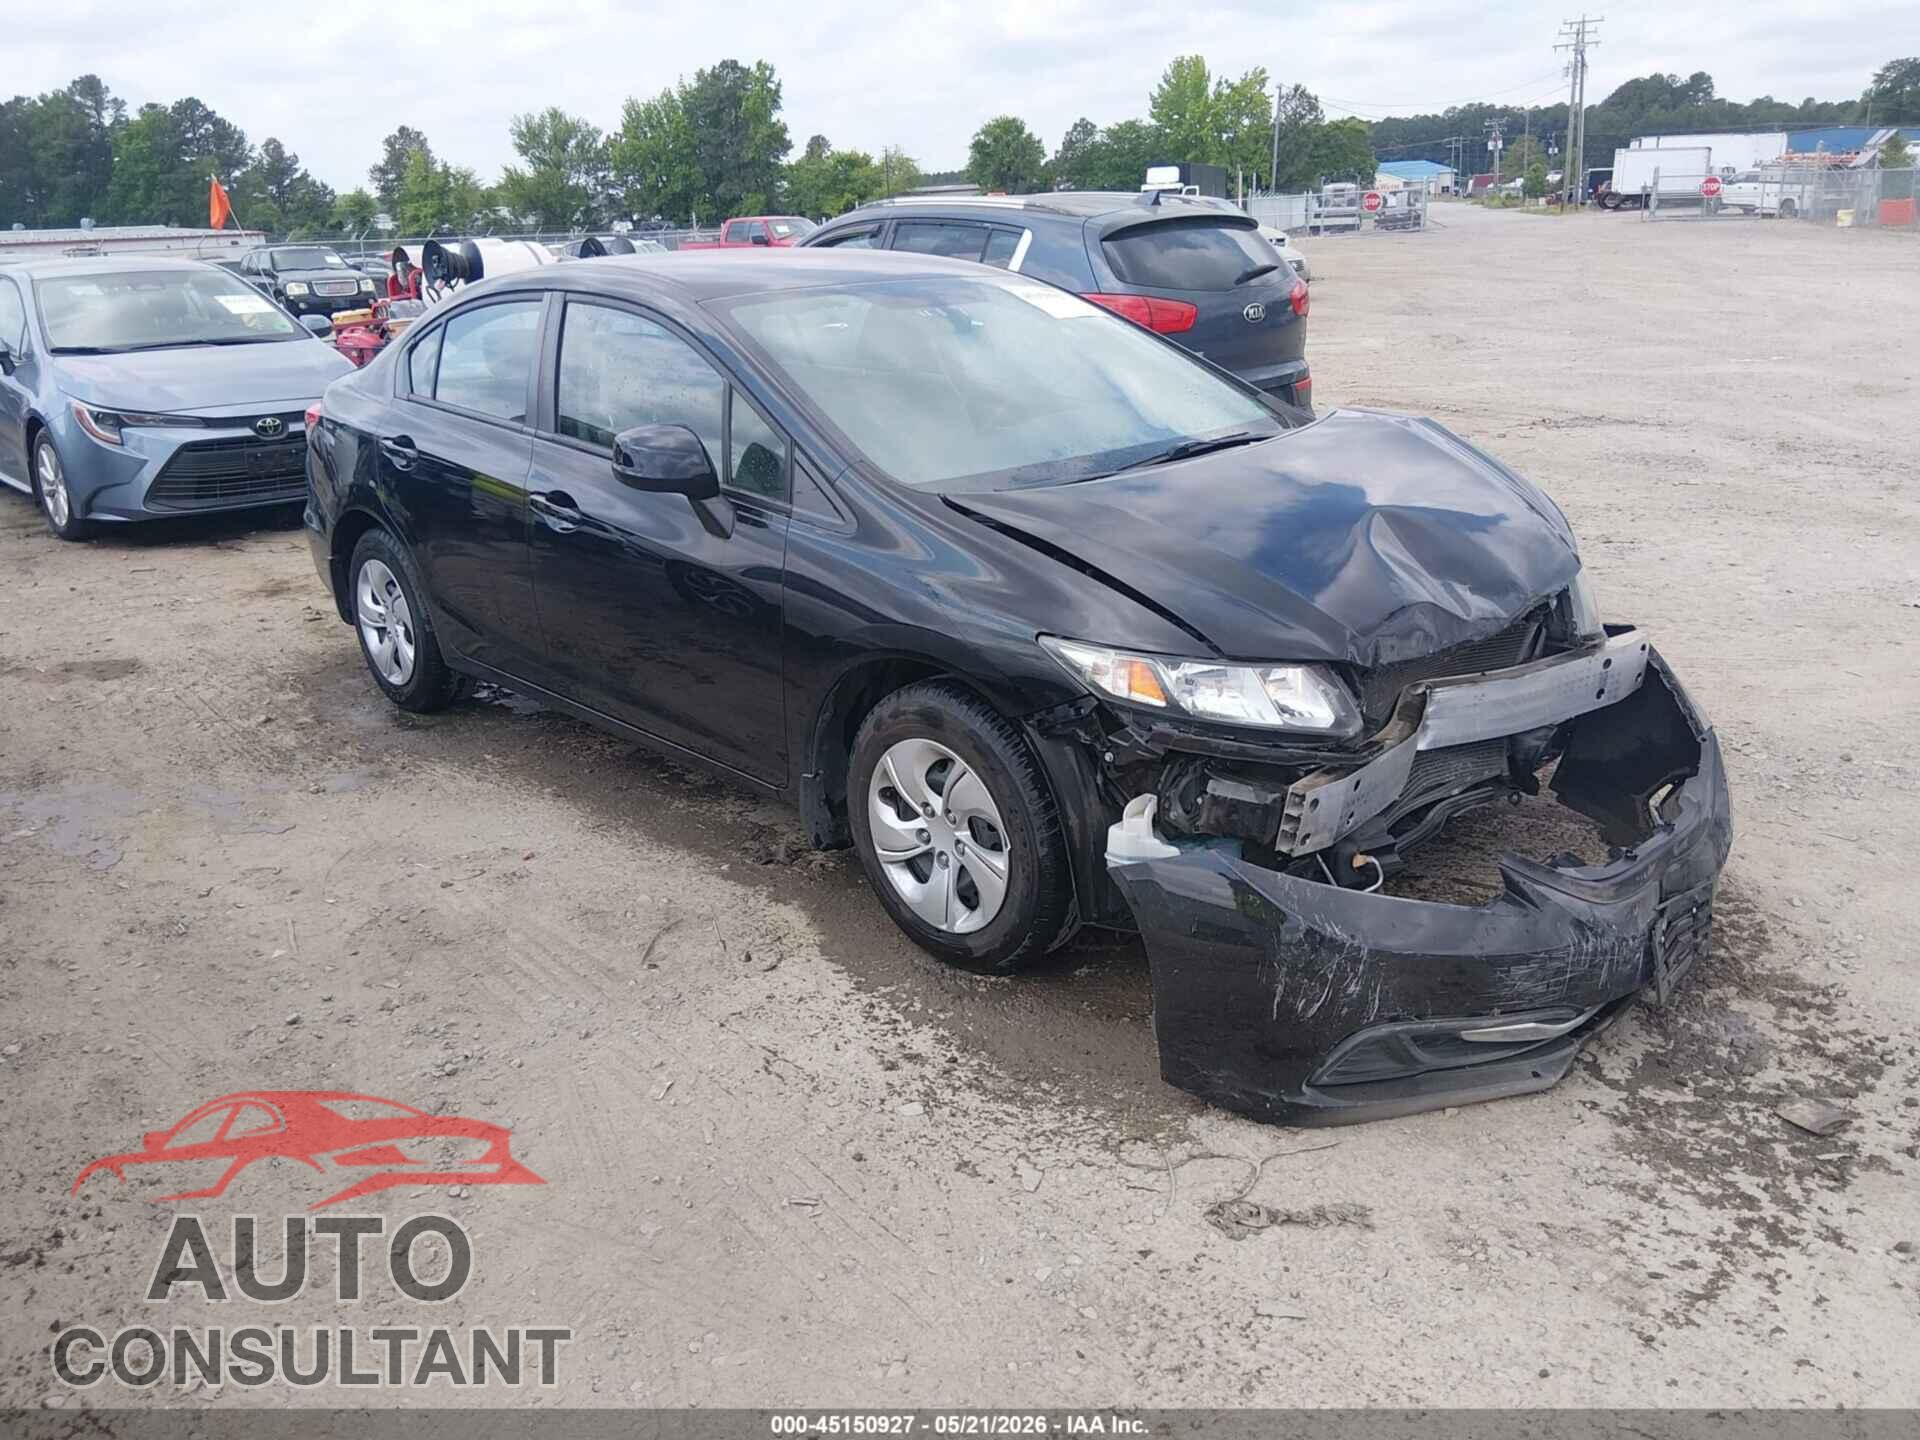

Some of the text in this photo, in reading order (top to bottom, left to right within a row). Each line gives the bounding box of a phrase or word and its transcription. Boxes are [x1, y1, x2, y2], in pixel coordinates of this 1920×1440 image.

[1701, 182, 1720, 192] STOP
[1364, 198, 1380, 206] STOP
[1248, 307, 1264, 319] KIA
